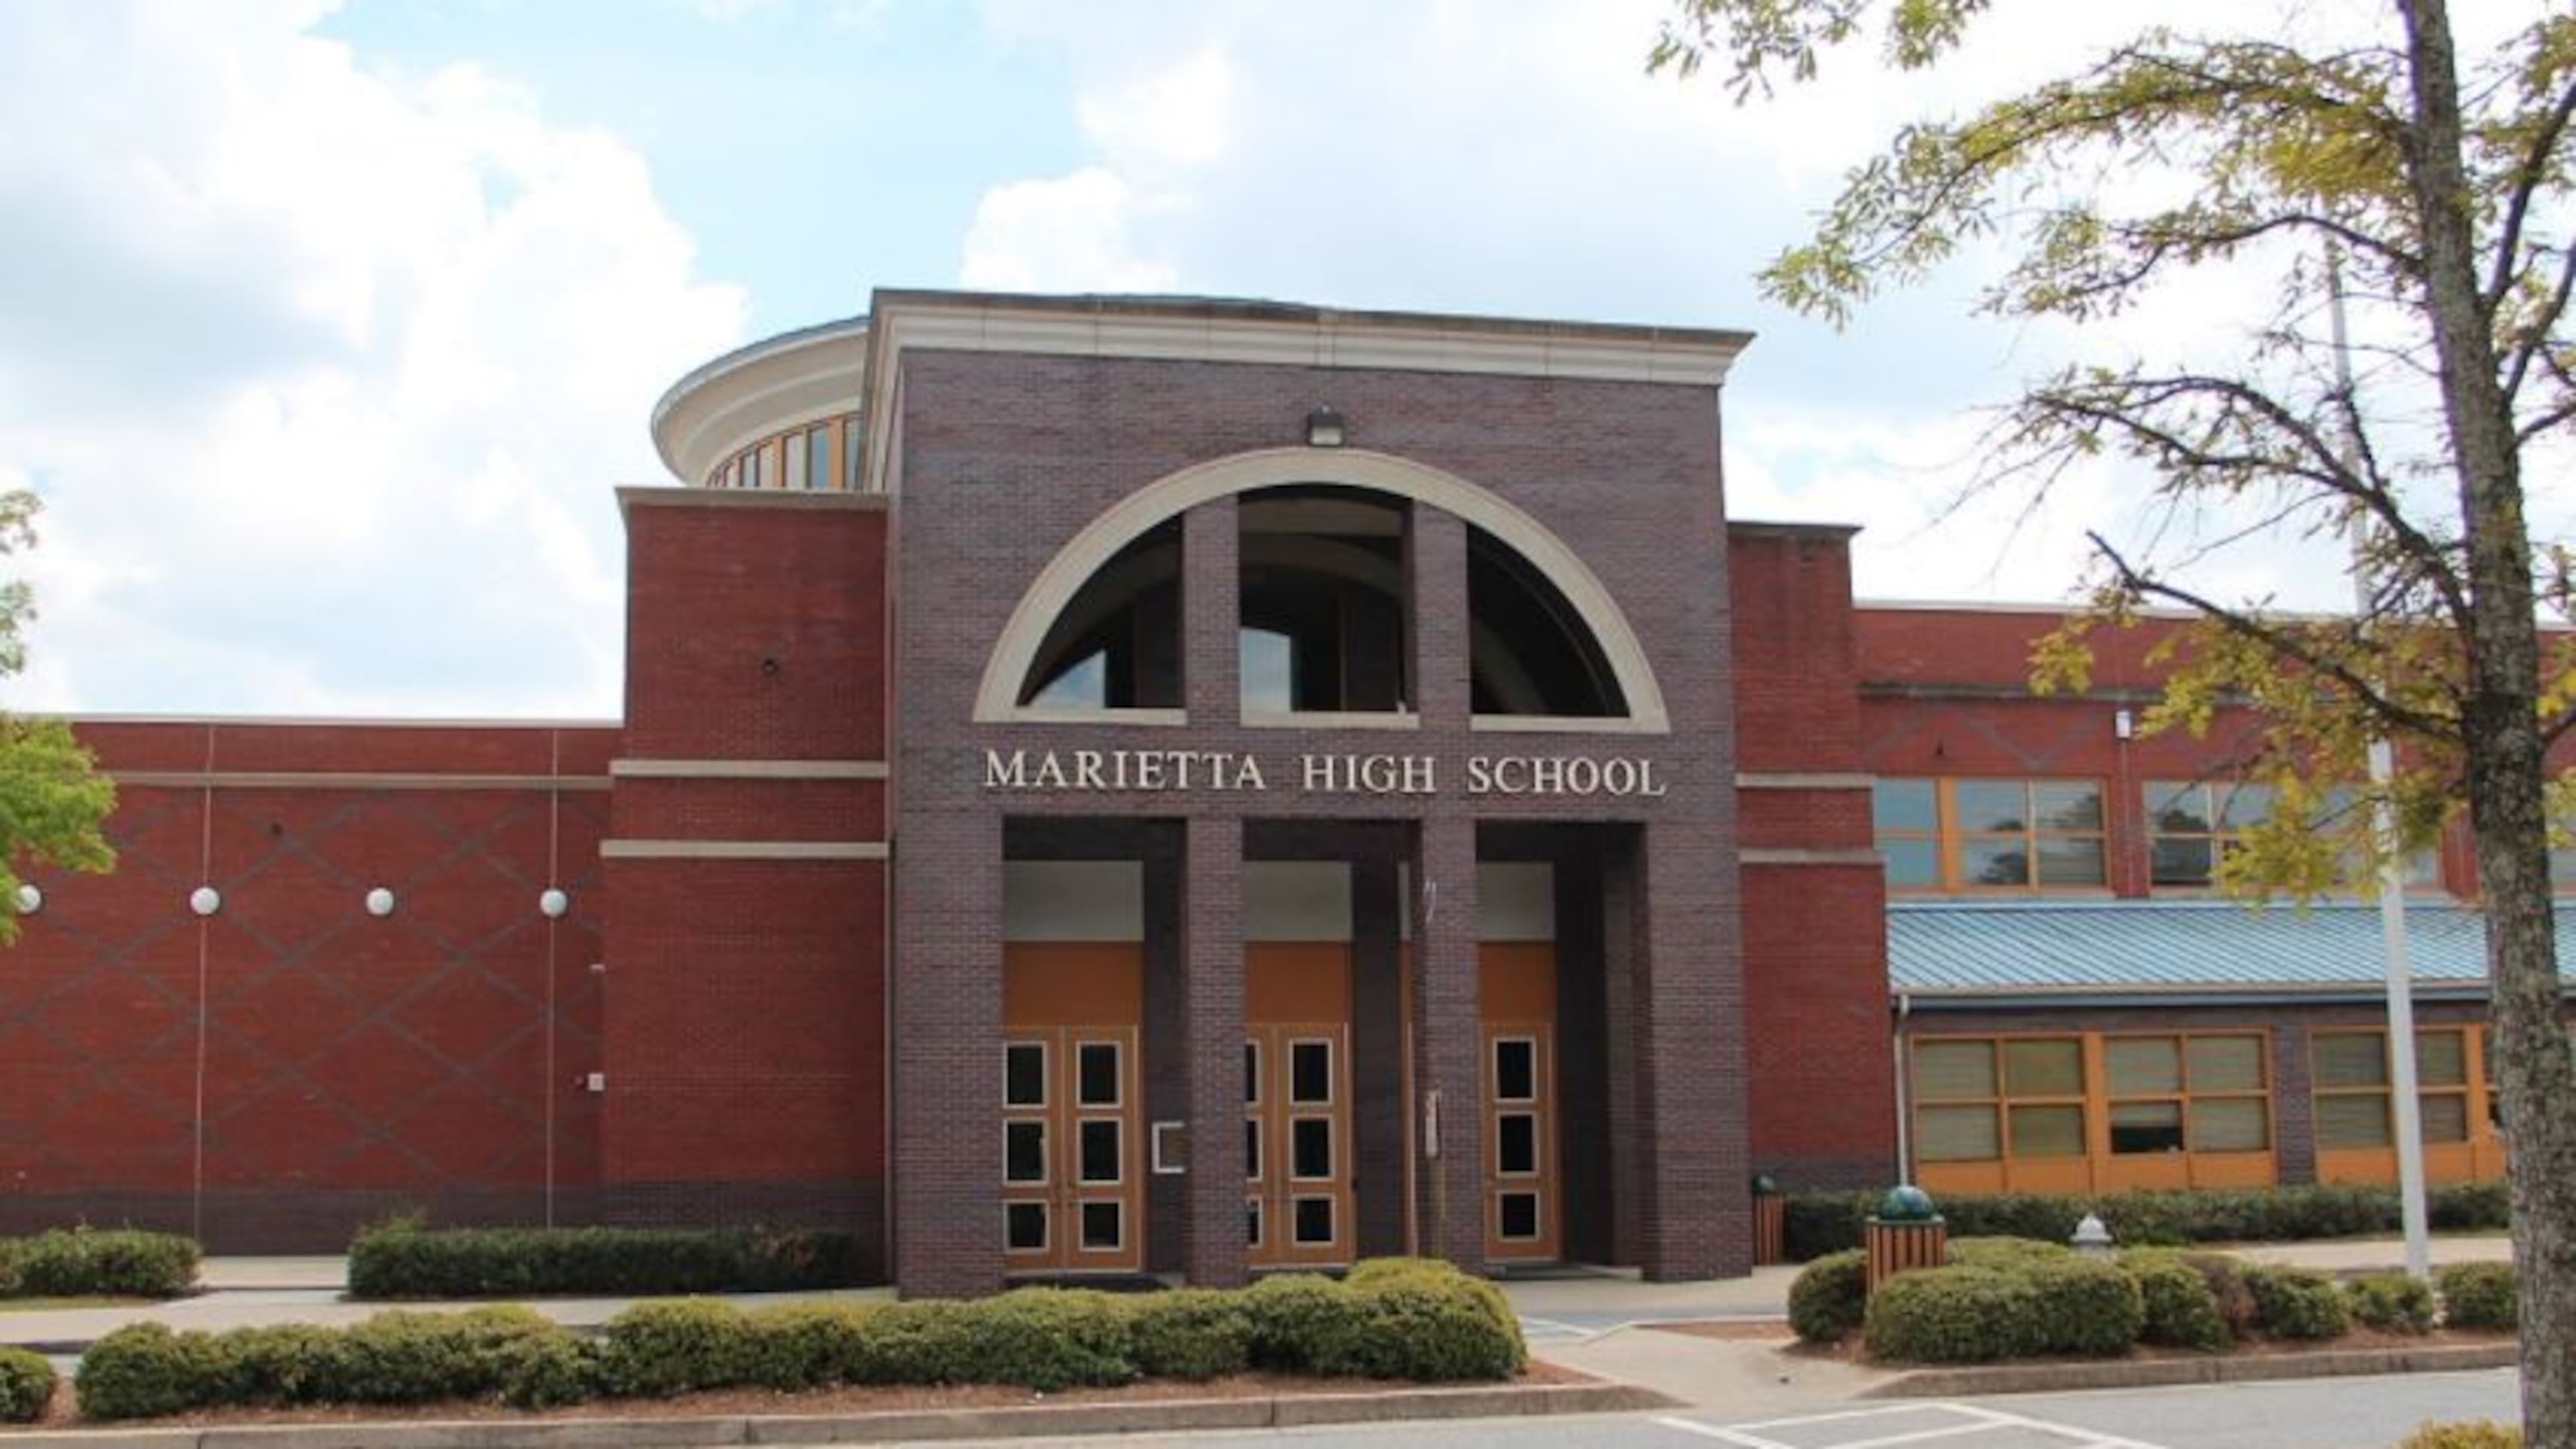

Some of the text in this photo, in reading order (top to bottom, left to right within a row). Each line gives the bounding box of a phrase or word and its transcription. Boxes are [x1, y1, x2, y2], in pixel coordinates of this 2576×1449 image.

[983, 748, 1668, 796] MARIETTA HIGH SCHOOL
